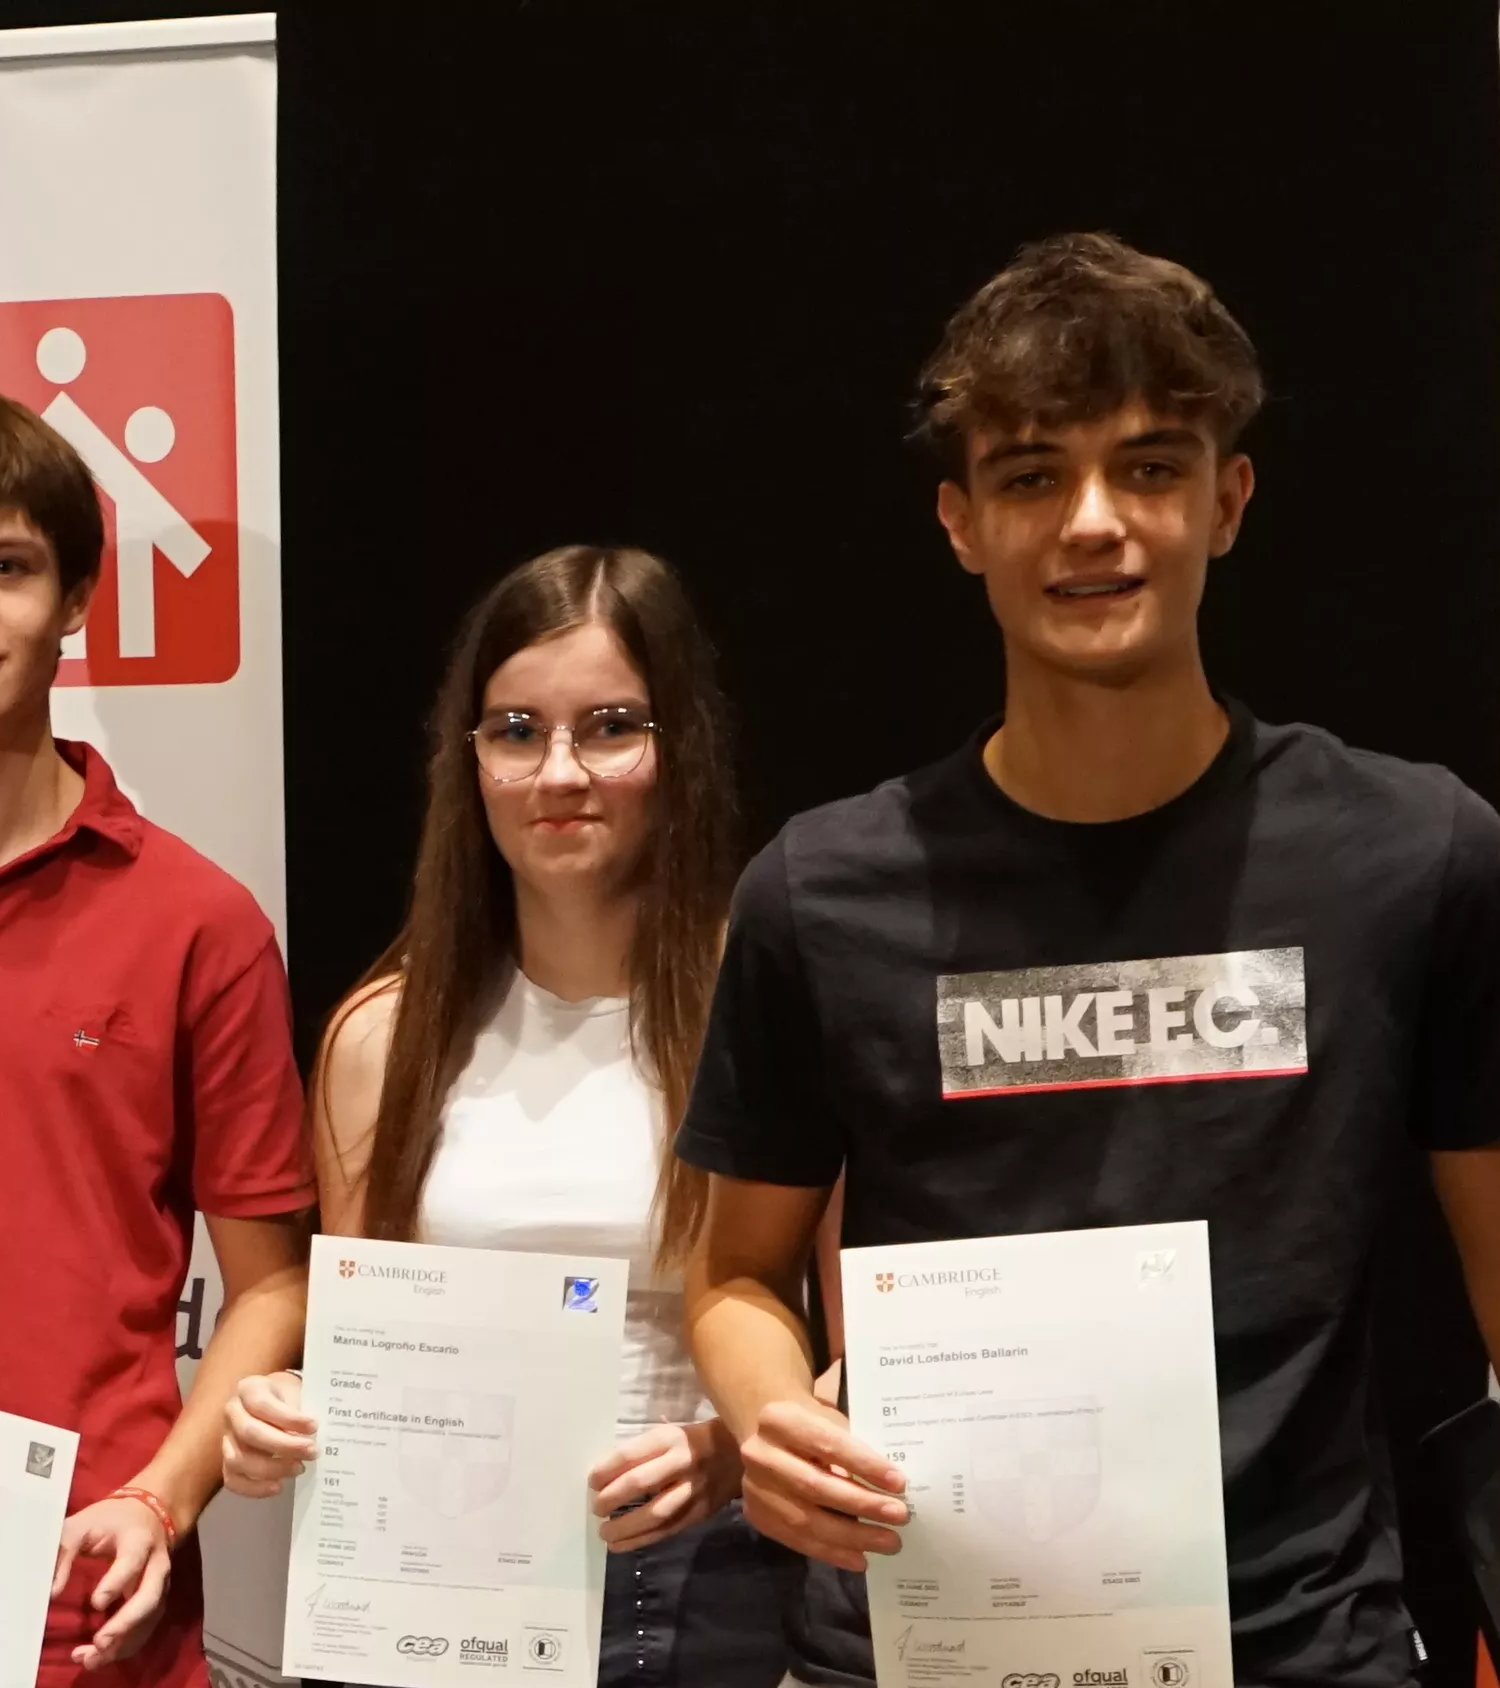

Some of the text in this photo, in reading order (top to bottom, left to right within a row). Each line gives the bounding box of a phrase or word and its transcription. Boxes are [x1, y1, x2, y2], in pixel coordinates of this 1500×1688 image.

[961, 990, 1136, 1068] NIKE
[357, 1263, 448, 1284] CAMBRIDGE
[897, 1267, 1002, 1288] CAMBRIDGE
[879, 1355, 914, 1367] David
[329, 1377, 373, 1391] Grade C
[327, 1406, 465, 1428] First Certificate in English
[882, 1406, 898, 1417] B1
[325, 1446, 340, 1456] B2
[460, 1636, 508, 1654] ofqual
[1072, 1667, 1129, 1685] ofqual
